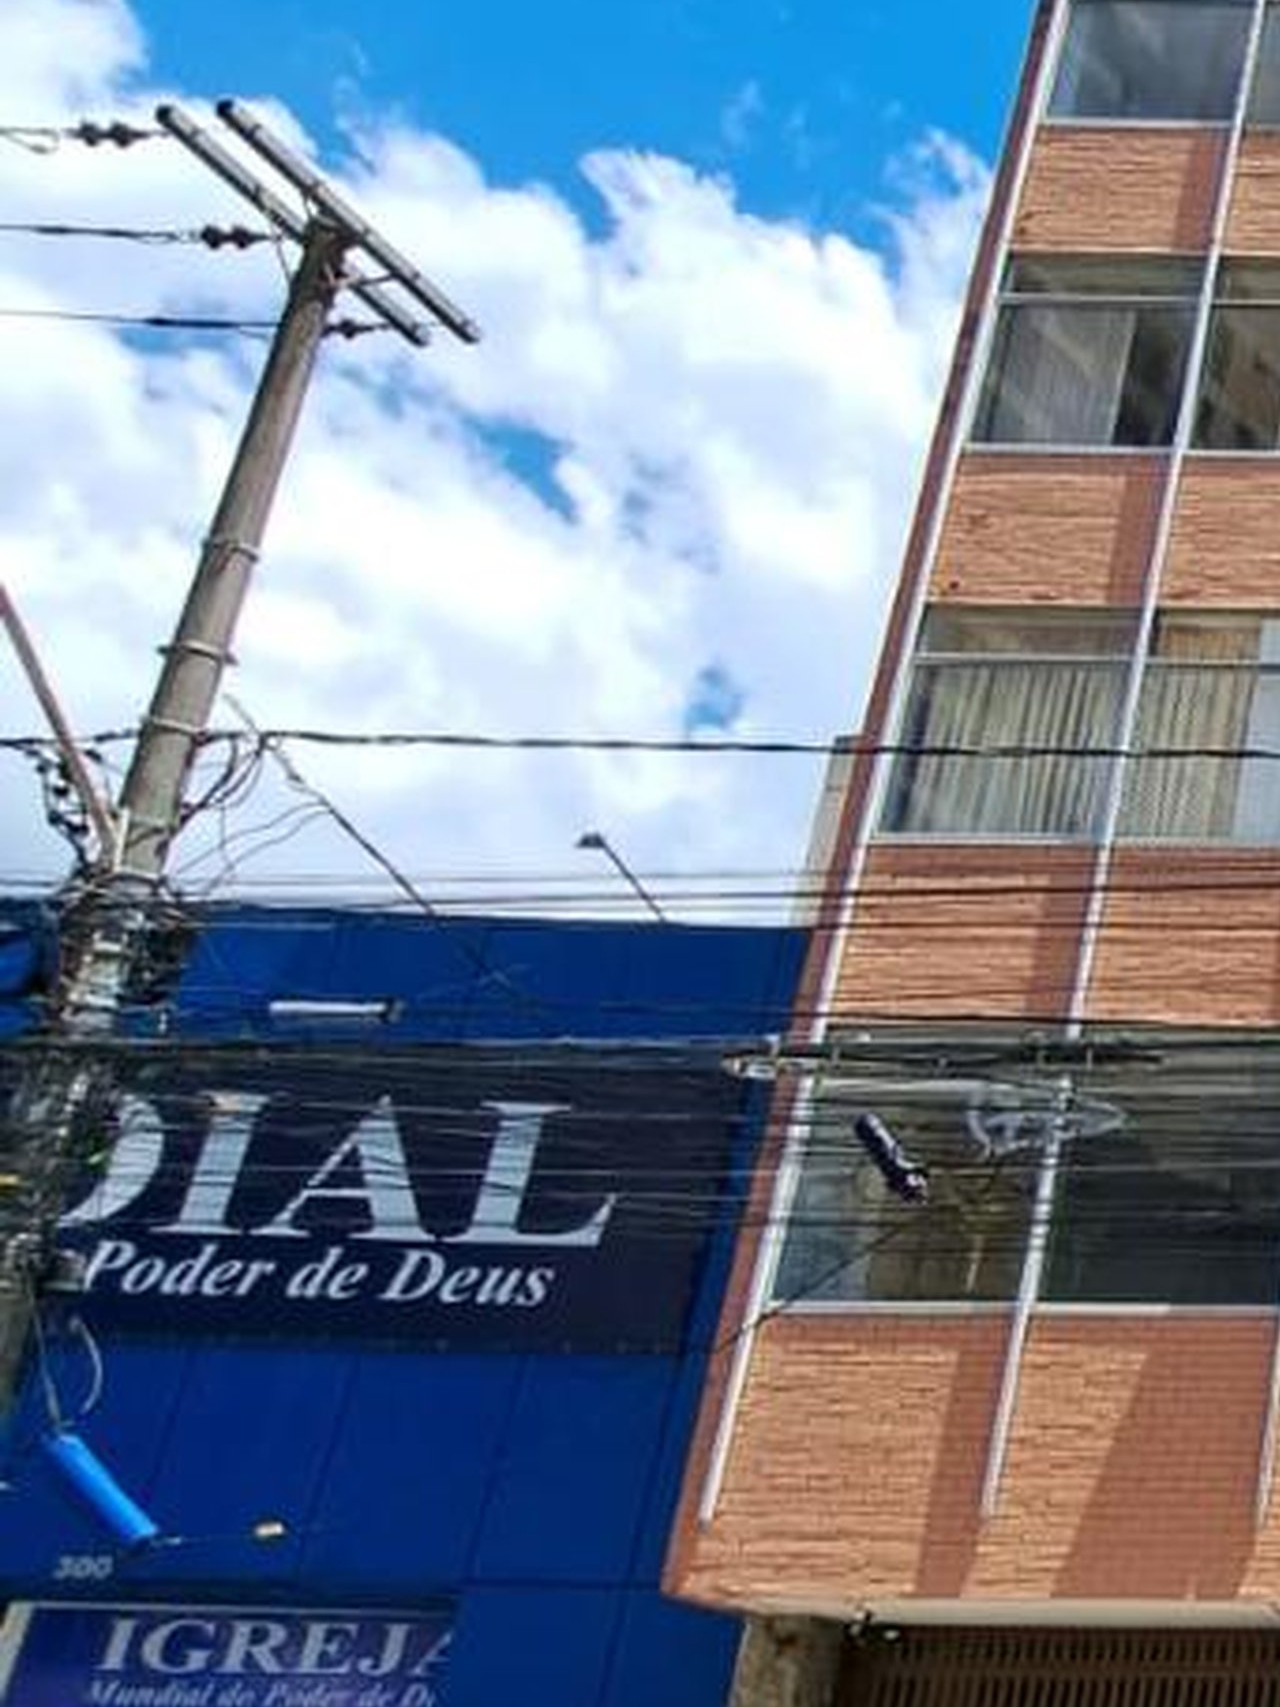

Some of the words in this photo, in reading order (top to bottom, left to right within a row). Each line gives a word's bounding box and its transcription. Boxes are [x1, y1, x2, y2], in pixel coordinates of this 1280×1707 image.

[82, 1239, 277, 1296] Poder
[285, 1243, 368, 1299] de
[380, 1249, 557, 1307] Deus
